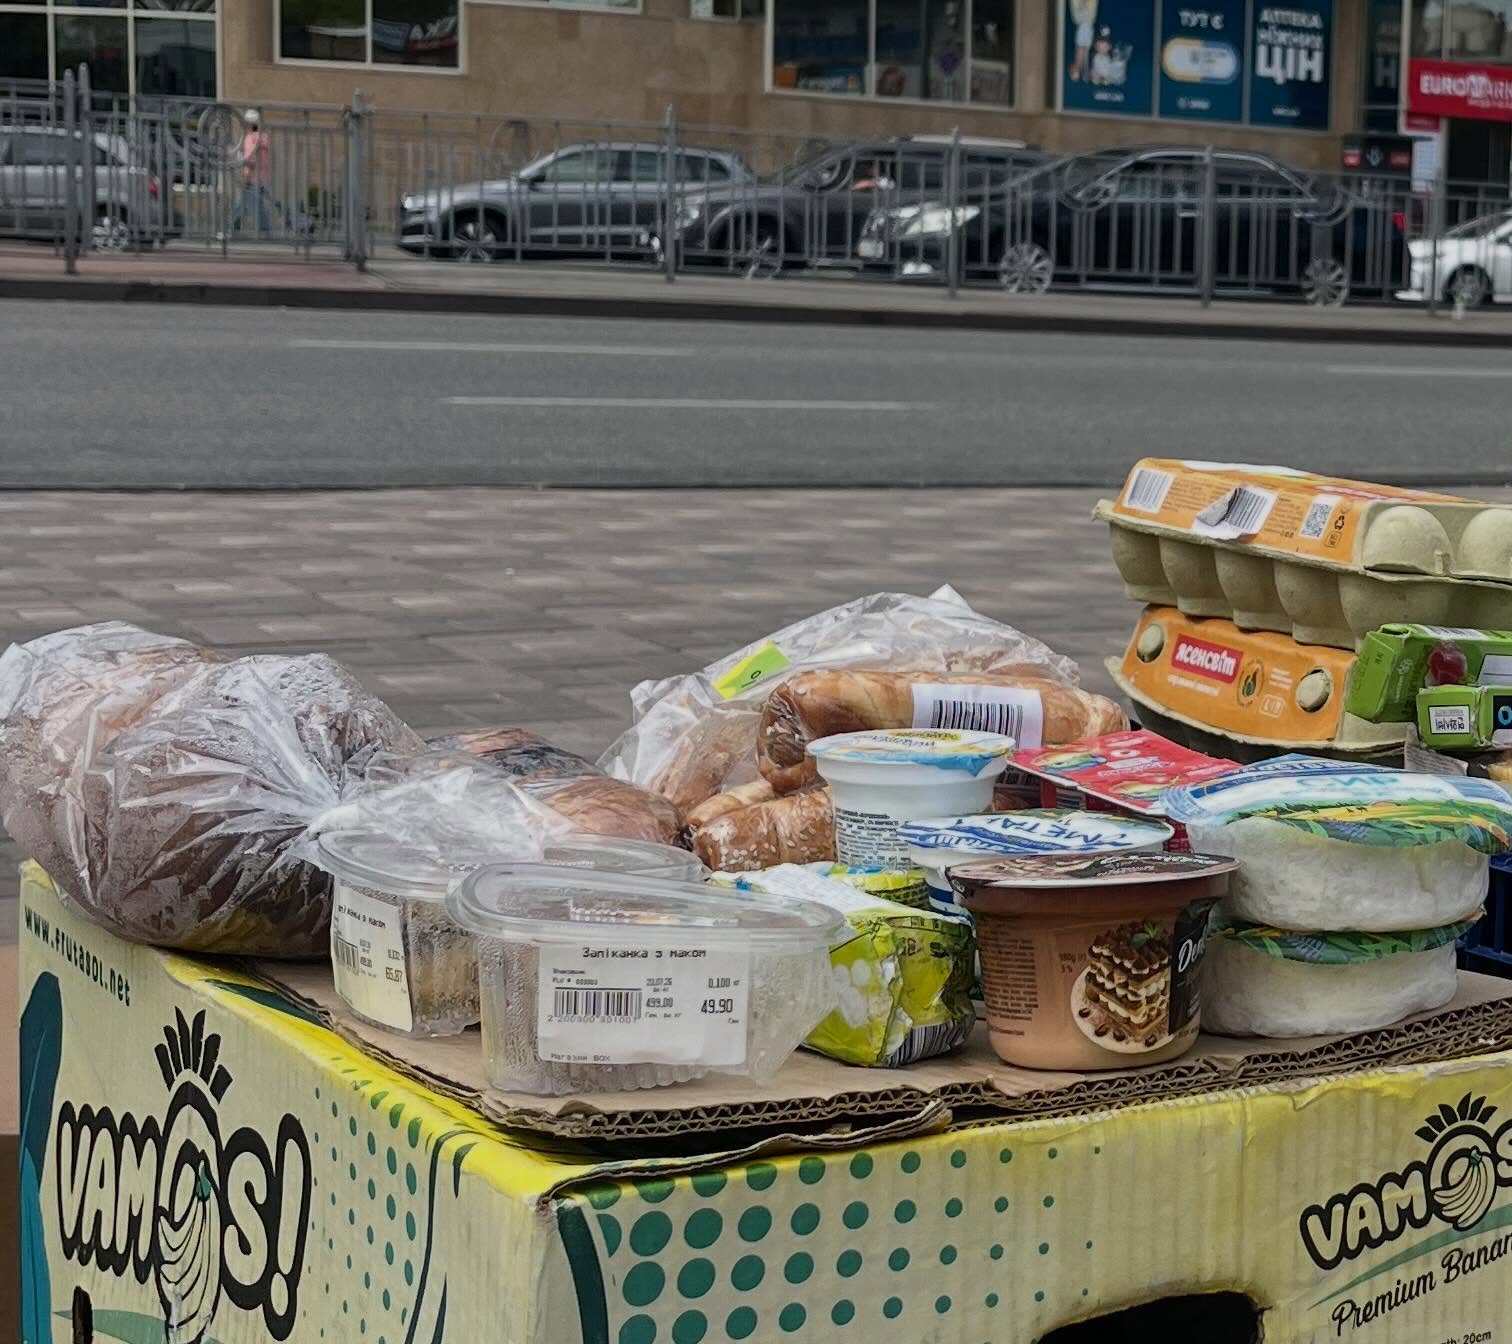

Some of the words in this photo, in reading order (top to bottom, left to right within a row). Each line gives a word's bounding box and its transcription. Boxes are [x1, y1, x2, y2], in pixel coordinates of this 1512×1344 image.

[1256, 45, 1323, 84] ЦІН
[24, 907, 131, 1008] www.frutasol.net
[582, 947, 649, 959] Запіканка
[670, 949, 707, 958] маком
[701, 999, 734, 1015] 49.90
[1332, 1269, 1437, 1337] Premium
